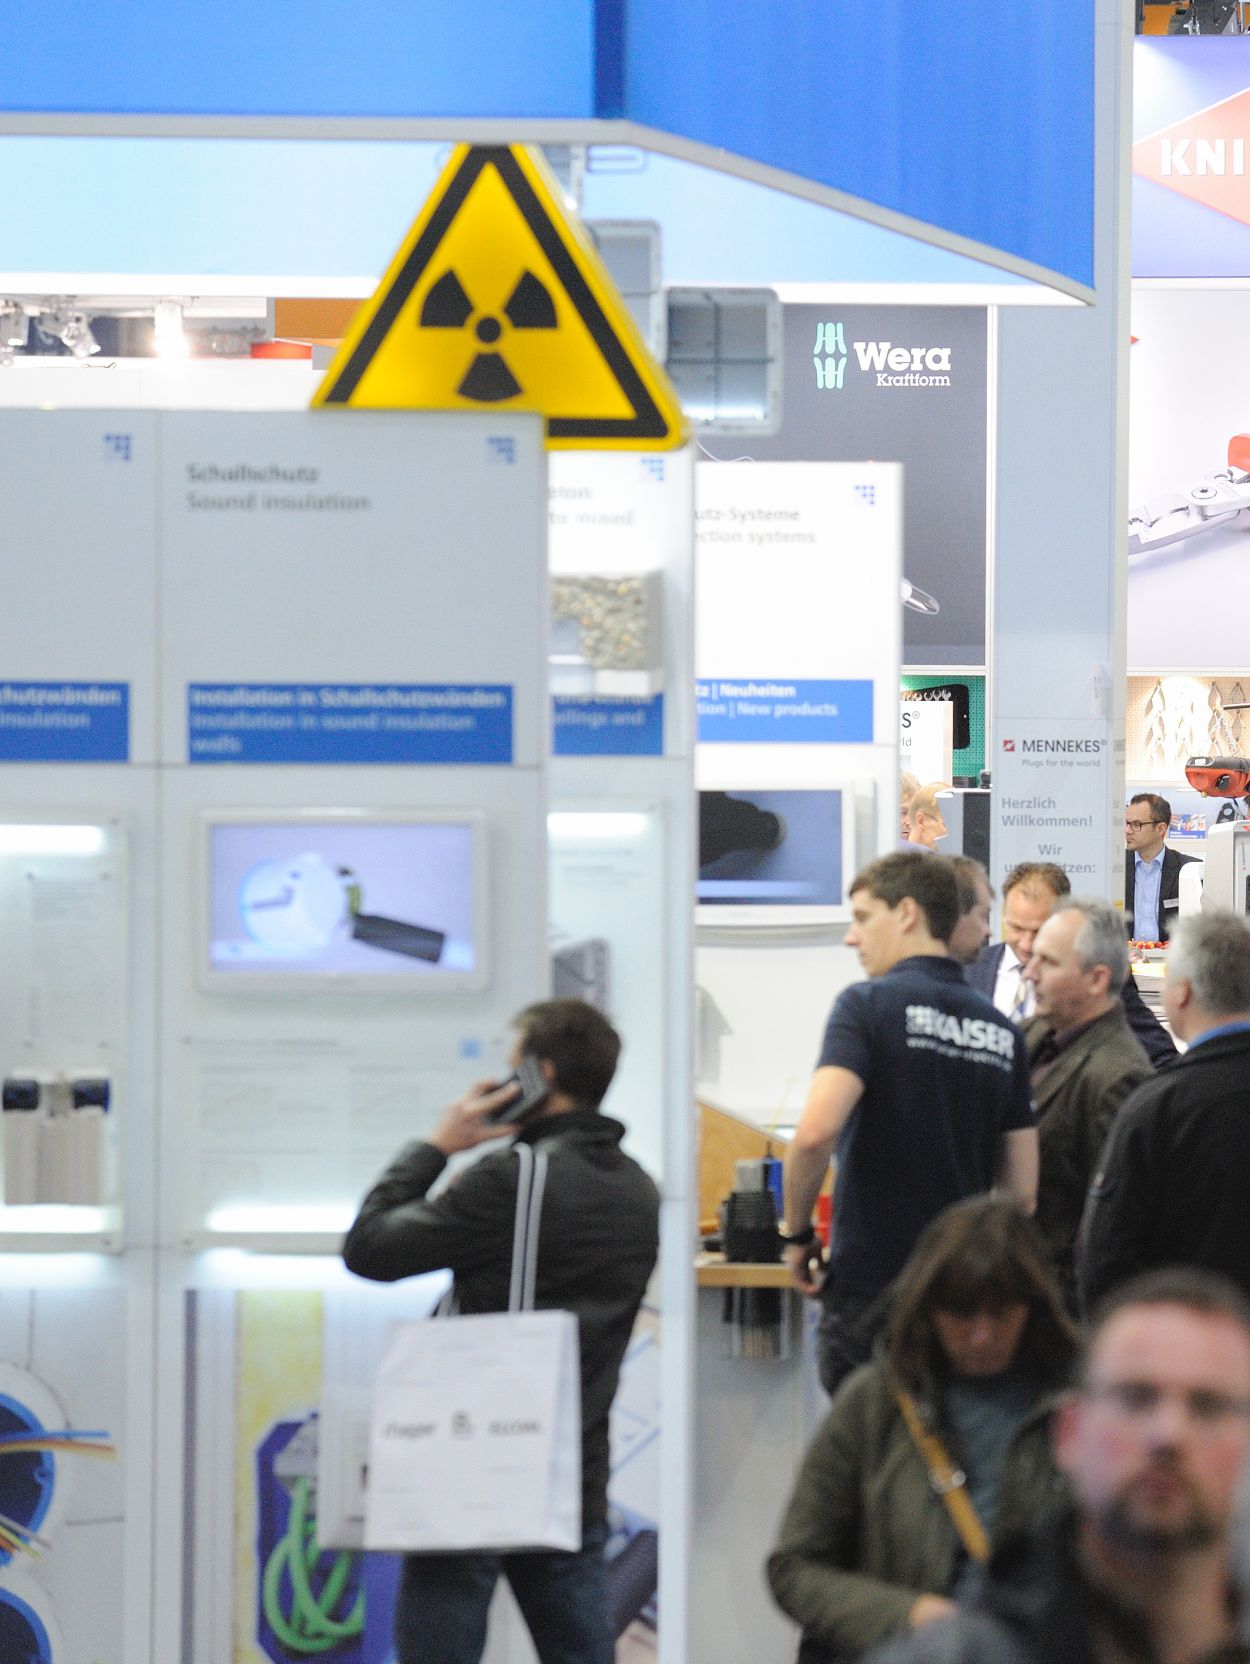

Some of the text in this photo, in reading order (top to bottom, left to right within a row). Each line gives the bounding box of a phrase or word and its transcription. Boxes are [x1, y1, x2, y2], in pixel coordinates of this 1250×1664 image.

[853, 341, 952, 372] Wera
[876, 372, 951, 387] Kraftform
[186, 463, 319, 484] Schallschutz
[187, 490, 371, 512] Sound insulation
[748, 530, 815, 547] systems
[720, 683, 797, 698] Neuheiten
[737, 702, 770, 715] New
[773, 701, 838, 719] products
[1022, 759, 1100, 768] Plugs for the world
[1001, 797, 1056, 809] Herzlich
[1001, 814, 1093, 827] Willkommen!
[1038, 844, 1062, 855] Wir
[935, 1011, 1015, 1060] KAISER
